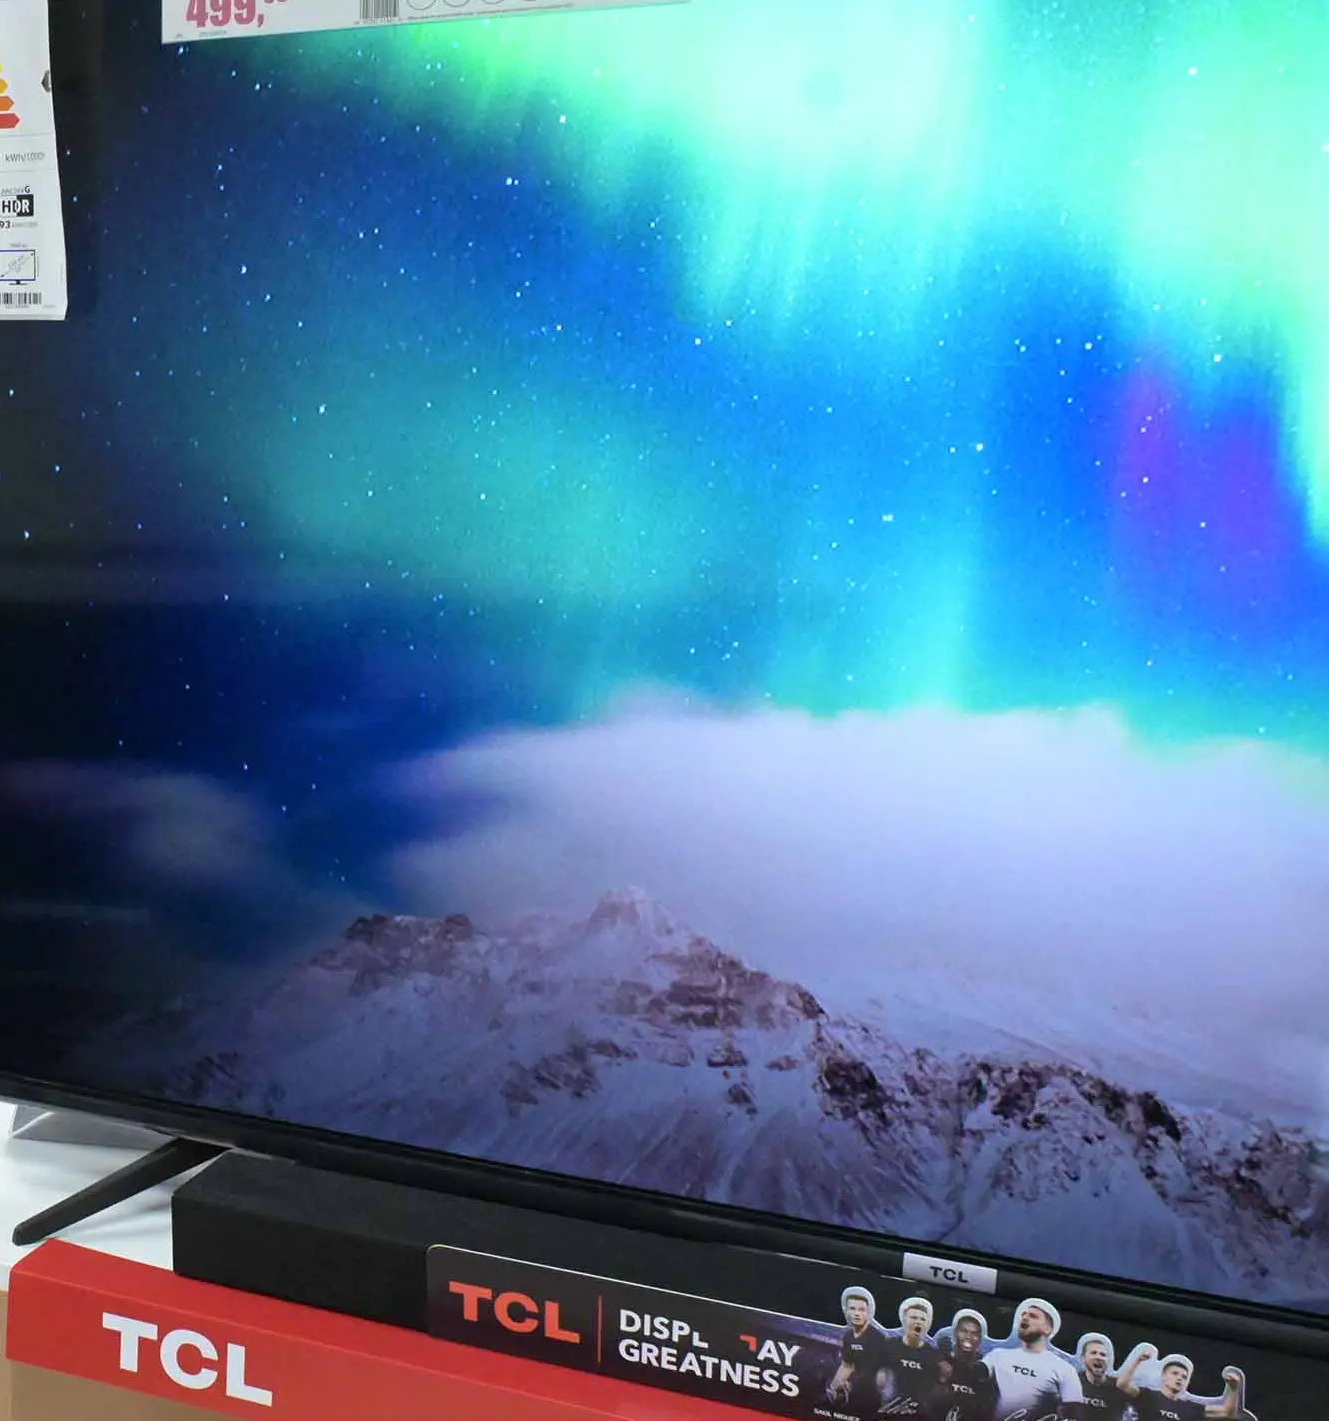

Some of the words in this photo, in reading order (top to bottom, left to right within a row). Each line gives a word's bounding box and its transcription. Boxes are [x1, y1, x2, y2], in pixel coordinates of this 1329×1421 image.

[185, 0, 288, 28] 499,
[2, 200, 30, 213] HDR
[0, 220, 11, 229] 93
[929, 1265, 969, 1284] TCL
[449, 1281, 581, 1345] TCL
[103, 1312, 273, 1408] TCL
[900, 1359, 923, 1371] TCL
[618, 1338, 801, 1398] GREATNESS
[1011, 1364, 1038, 1378] TCL
[952, 1383, 976, 1395] TCL
[1159, 1409, 1180, 1420] TCL
